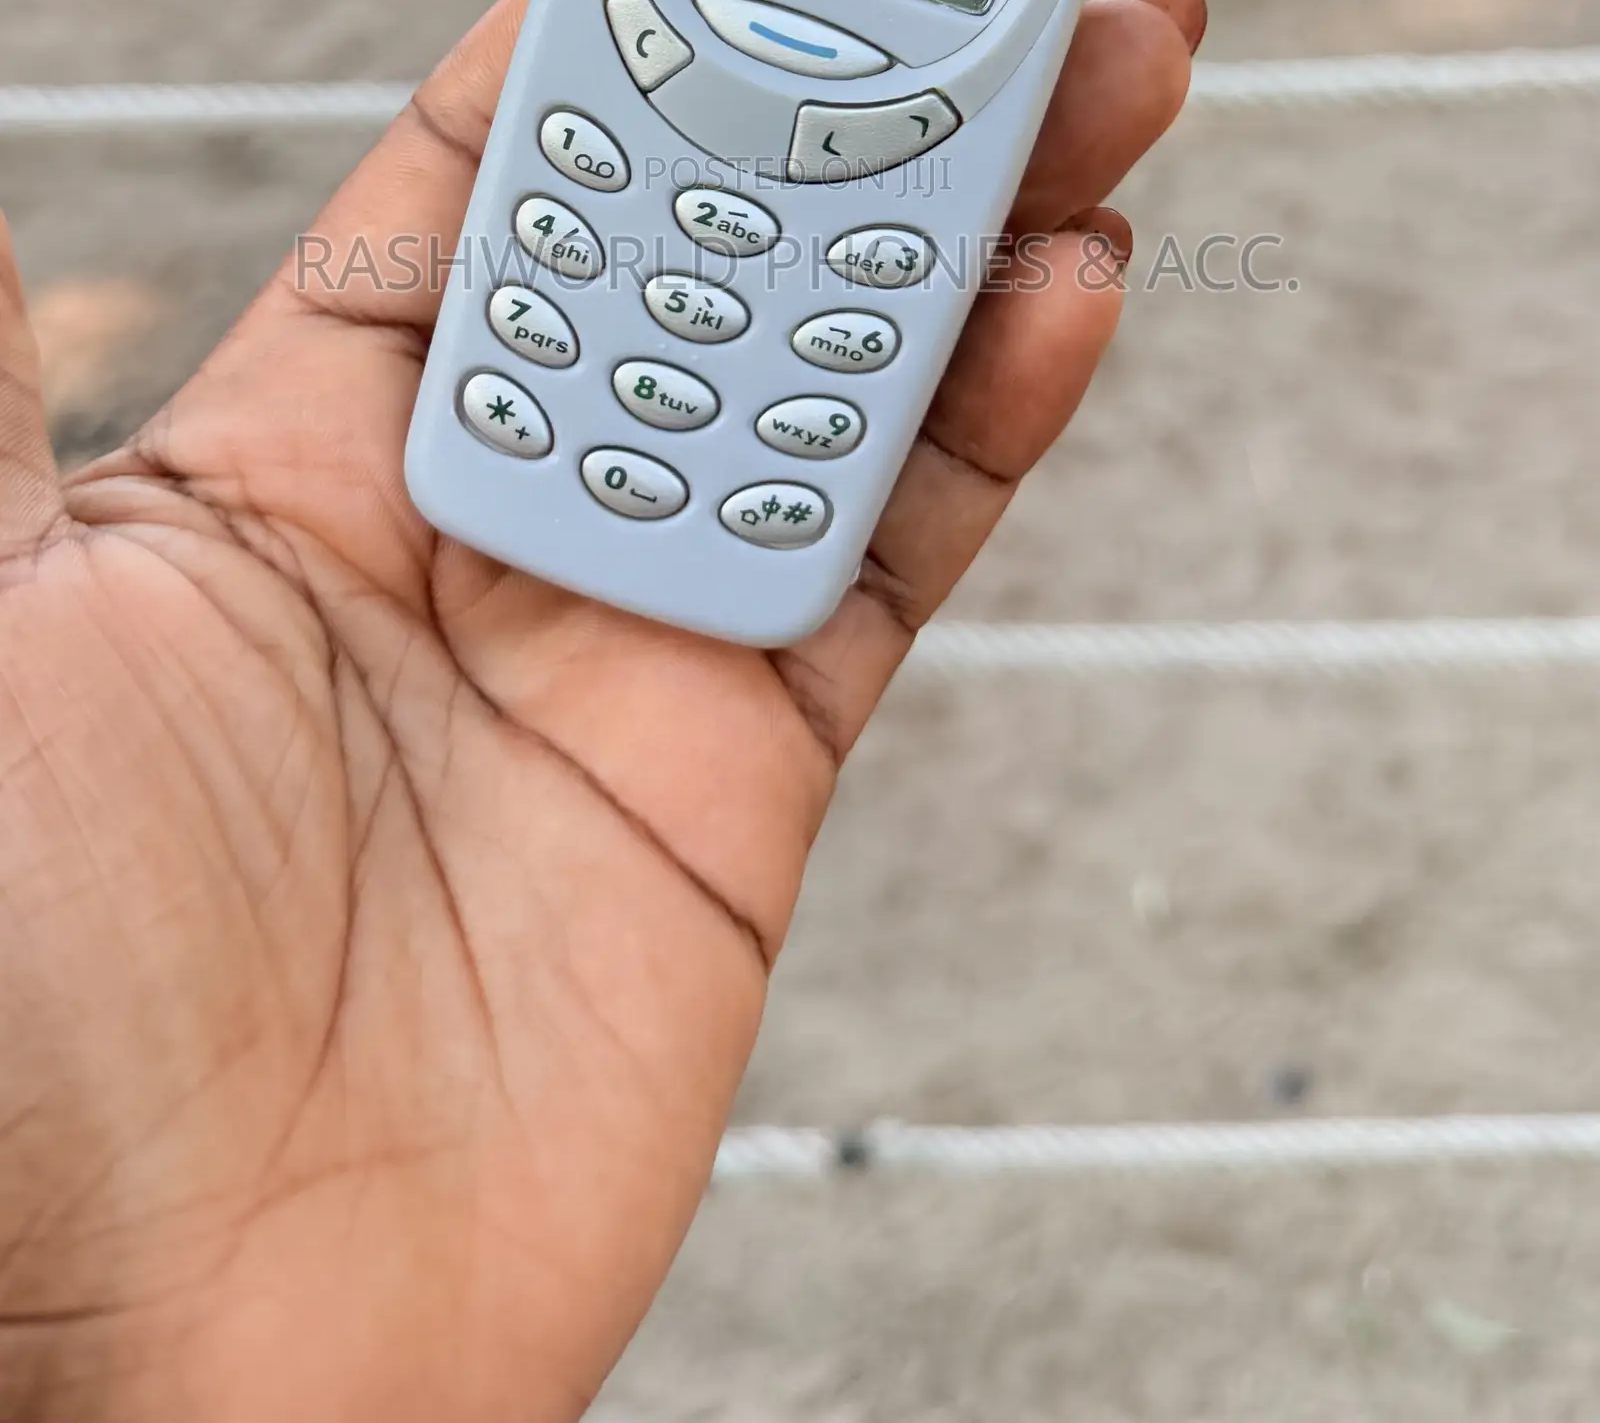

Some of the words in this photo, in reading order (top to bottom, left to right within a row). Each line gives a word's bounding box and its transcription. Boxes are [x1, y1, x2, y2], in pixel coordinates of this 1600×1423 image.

[562, 127, 576, 151] 1
[692, 201, 719, 227] 2
[716, 218, 761, 245] abc
[532, 214, 556, 238] 4
[551, 241, 589, 265] ghi
[844, 251, 885, 275] def
[895, 246, 919, 272] 3
[506, 298, 532, 322] 7
[663, 289, 689, 314] 5
[690, 306, 724, 330] jkl
[514, 325, 569, 354] pqrs
[810, 334, 863, 362] mno
[861, 330, 884, 354] 6
[633, 374, 657, 400] 8
[658, 391, 699, 415] tuv
[772, 417, 833, 449] wxyz
[828, 412, 851, 436] 9
[604, 465, 628, 490] 0
